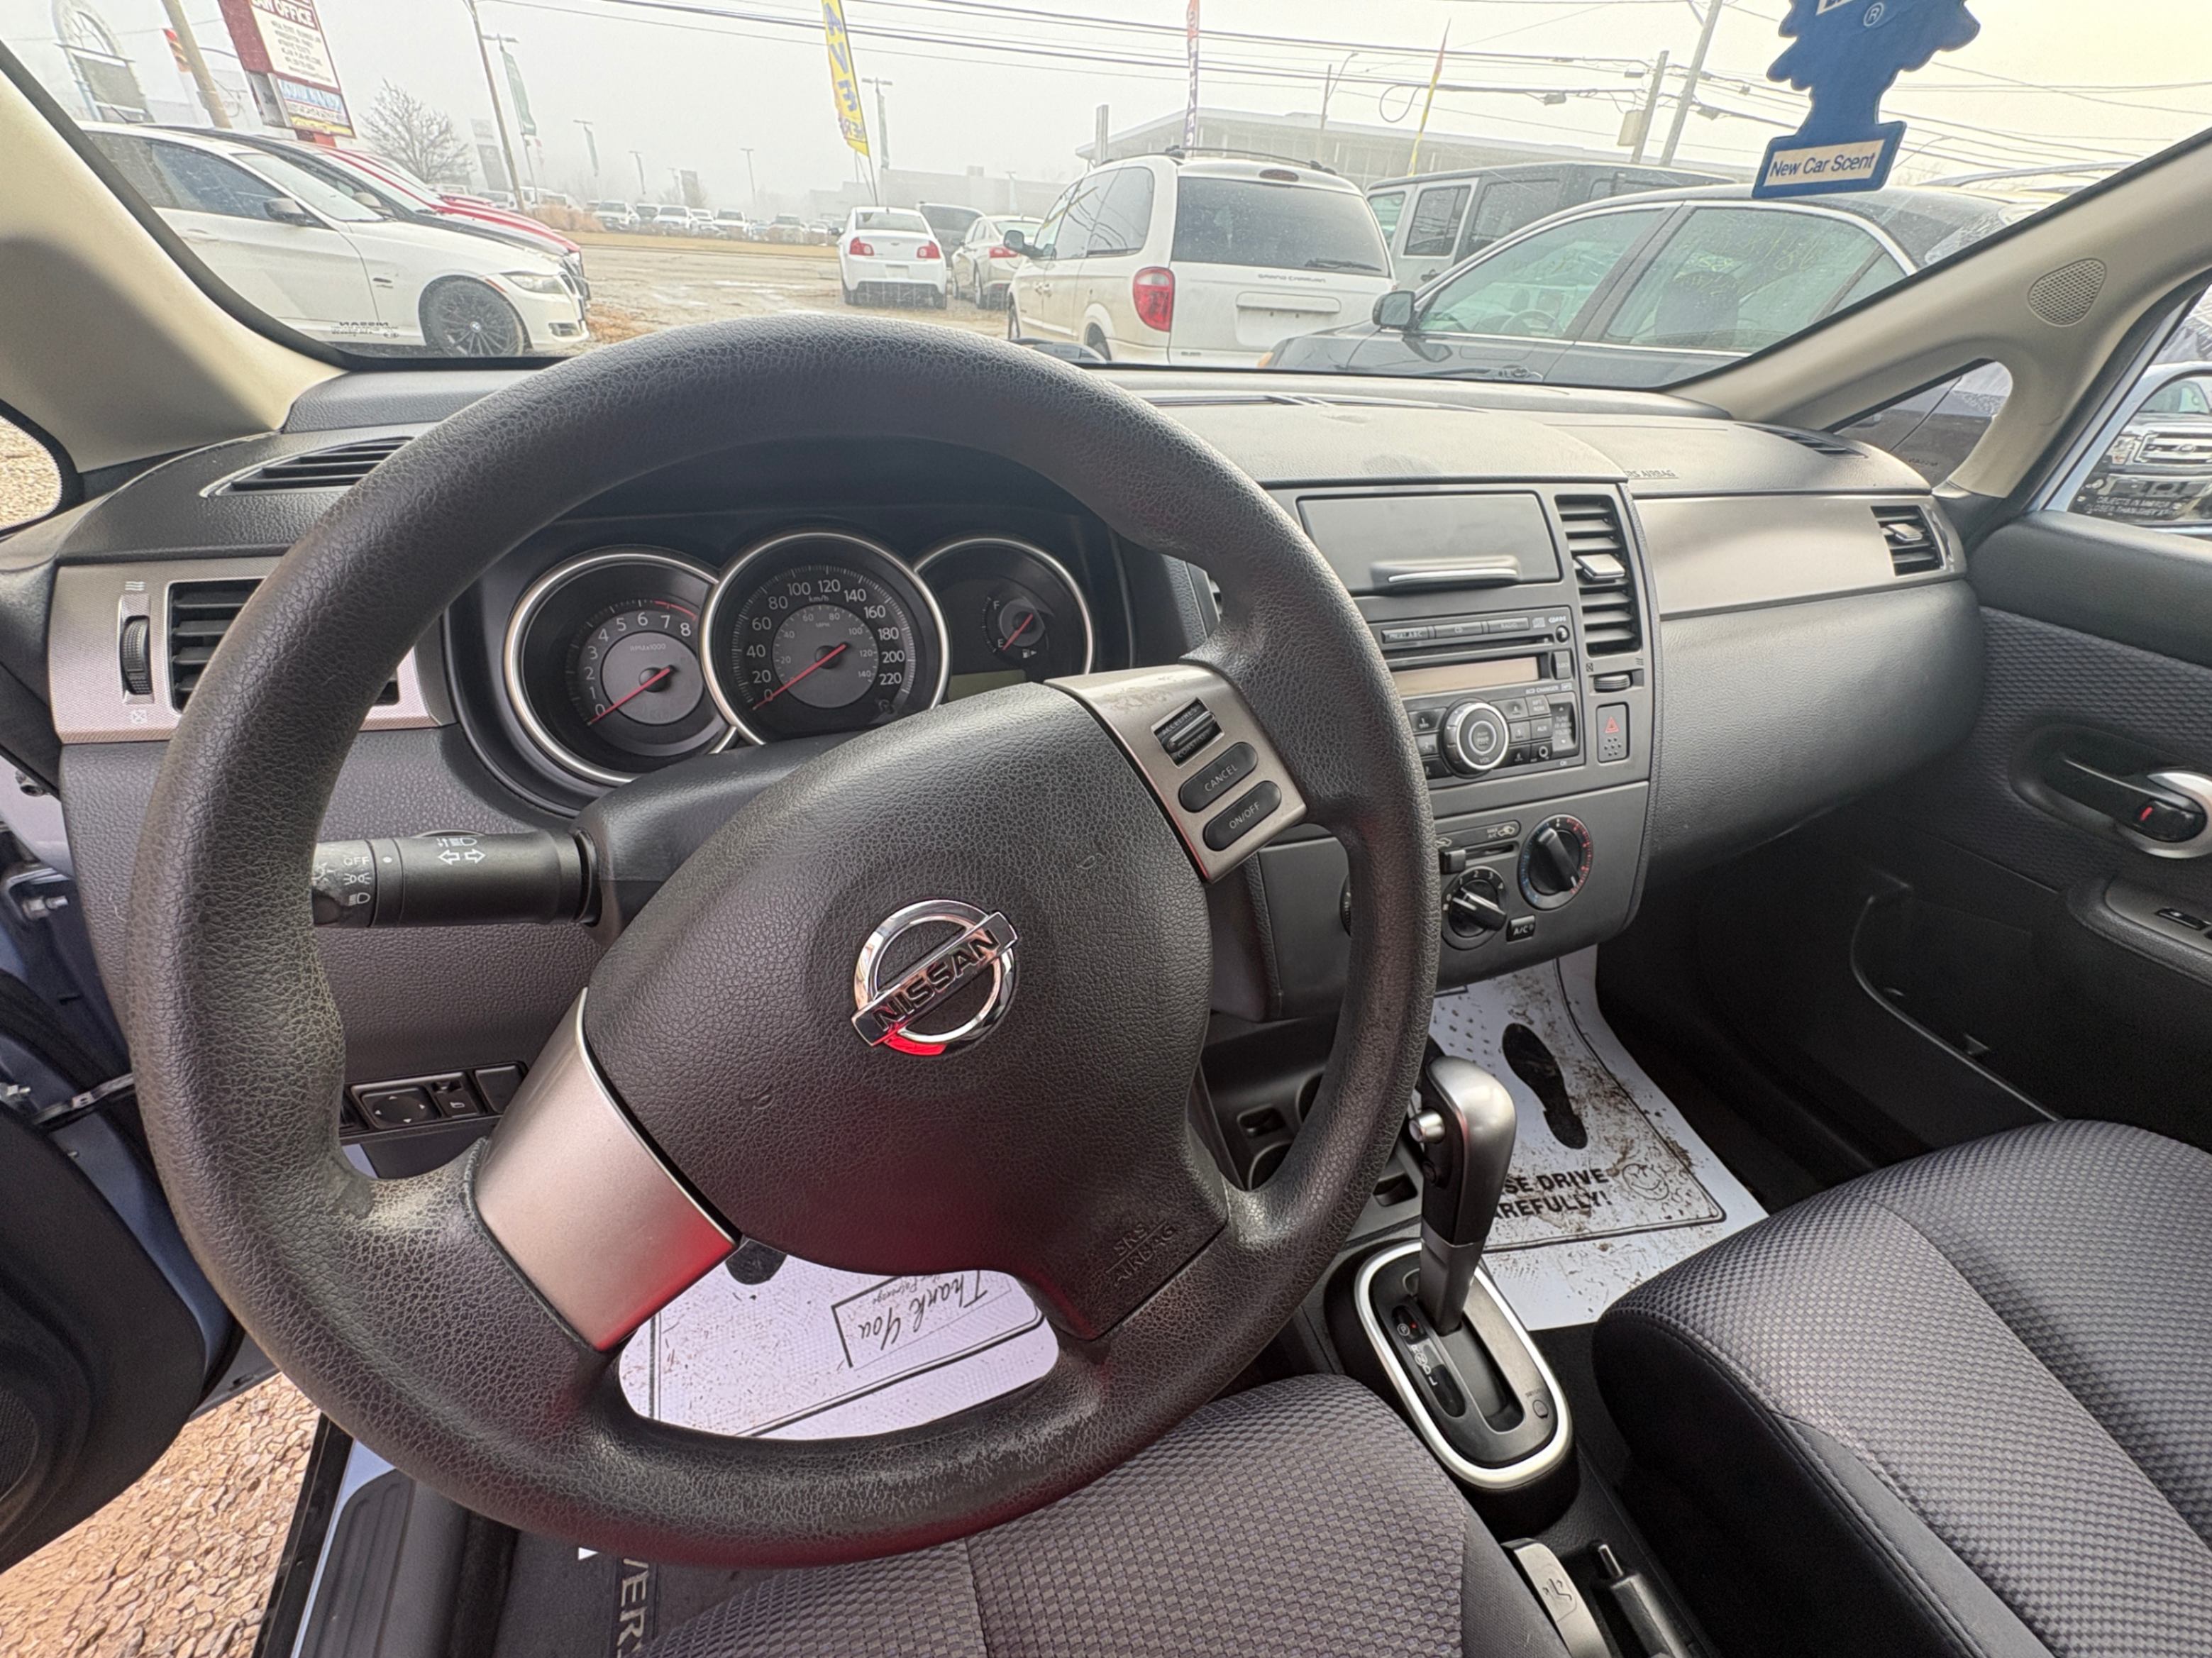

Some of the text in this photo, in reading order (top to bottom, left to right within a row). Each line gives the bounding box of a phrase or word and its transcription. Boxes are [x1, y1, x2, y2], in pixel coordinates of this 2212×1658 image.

[1770, 153, 1875, 177] New Car Scent
[787, 582, 811, 596] 100
[818, 579, 841, 593] 120
[768, 595, 788, 609] 80
[844, 588, 866, 602] 140
[863, 605, 886, 619] 160
[993, 600, 1000, 610] F
[637, 612, 648, 626] 6
[660, 615, 670, 629] 7
[829, 612, 840, 621] 80
[616, 617, 626, 631] 5
[680, 622, 692, 636] 8
[752, 617, 772, 631] 60
[598, 629, 609, 642] 4
[878, 627, 900, 640] 180
[997, 639, 1005, 648] E
[588, 646, 598, 660] 3
[746, 644, 766, 658] 40
[882, 650, 905, 663] 200
[584, 666, 595, 680] 2
[752, 670, 772, 684] 20
[879, 673, 902, 685] 220
[590, 686, 596, 700] 1
[764, 689, 773, 701] 0
[595, 703, 606, 717] 0
[1204, 763, 1239, 792] CANCEL
[1229, 802, 1261, 829] ON/OFF
[343, 856, 370, 866] OFF
[1488, 871, 1494, 880] 3
[1513, 927, 1529, 936] A/C
[872, 929, 1001, 1032] NISSAN
[1503, 1168, 1610, 1194] SE DRIVE
[1494, 1190, 1613, 1219] REFULLY!
[857, 1269, 988, 1351] Thank You
[1410, 1344, 1420, 1354] R
[1422, 1364, 1432, 1375] D
[1428, 1376, 1438, 1386] L
